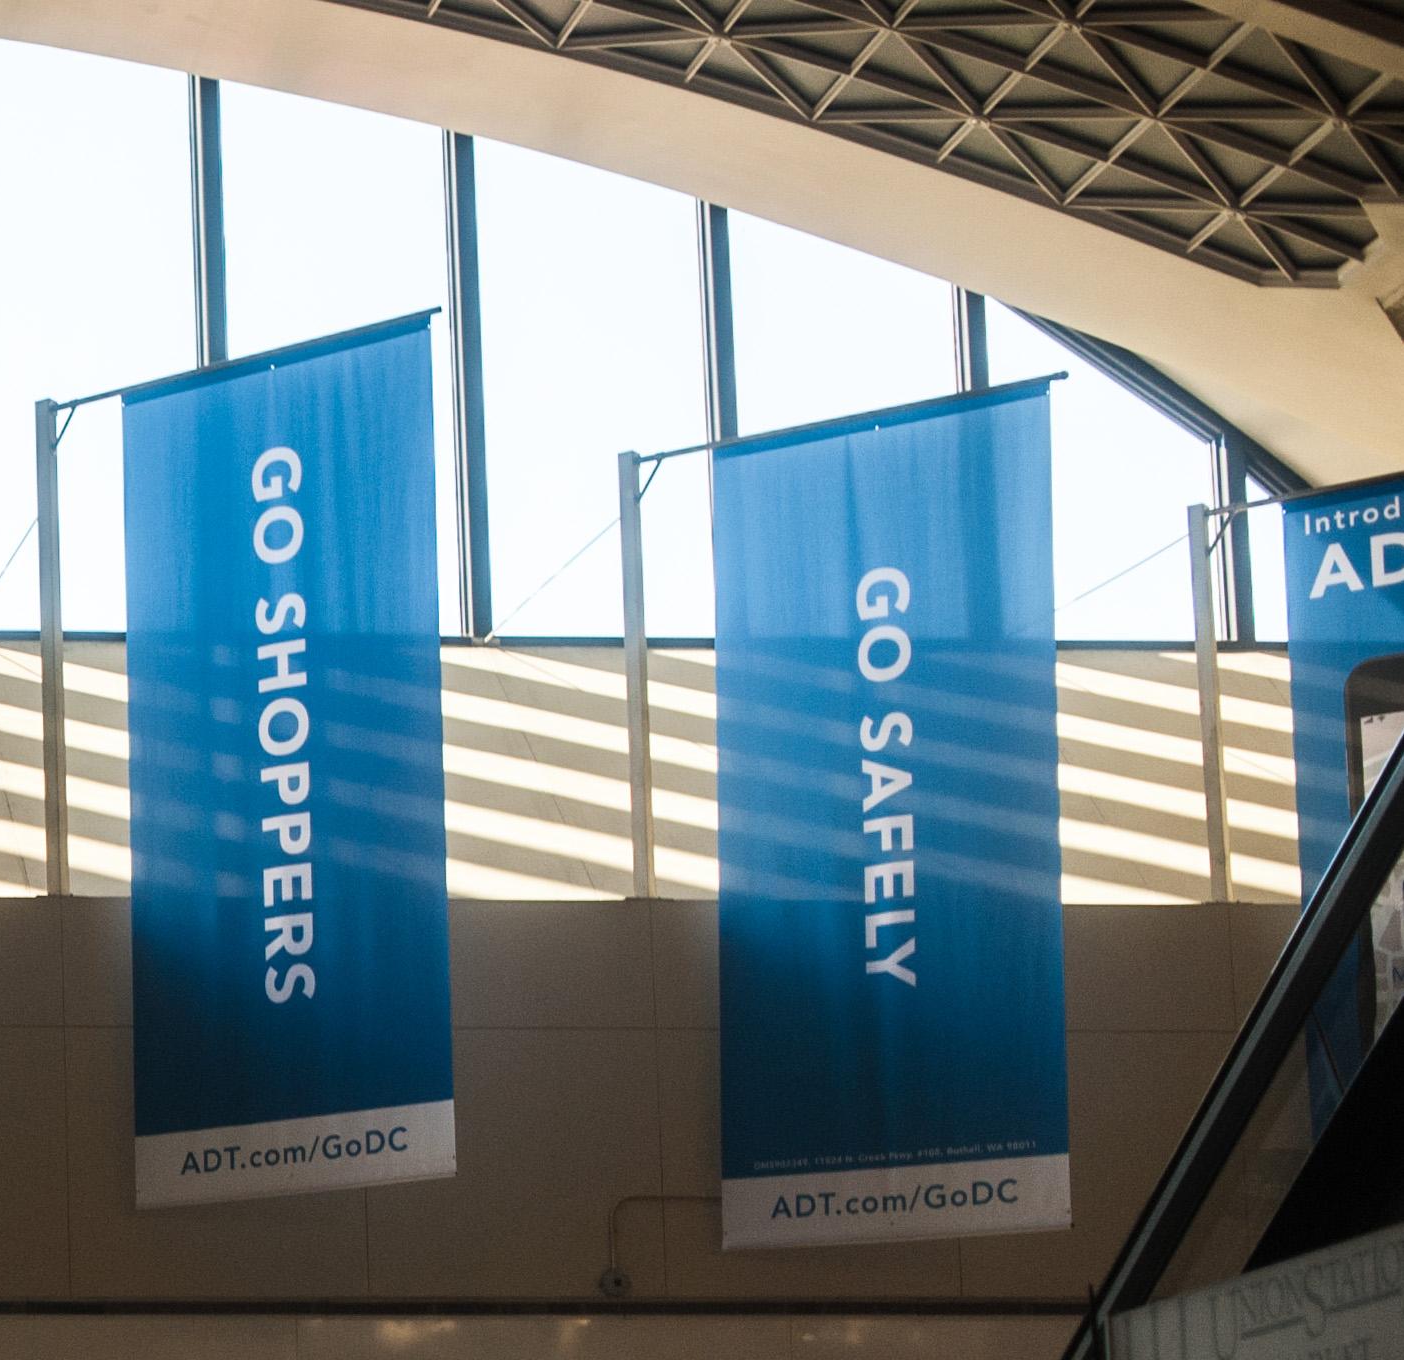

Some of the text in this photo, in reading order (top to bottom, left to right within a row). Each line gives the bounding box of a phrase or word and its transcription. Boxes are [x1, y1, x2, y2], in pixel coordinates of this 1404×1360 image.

[251, 446, 316, 1004] GO SHOPPERS
[855, 566, 917, 988] GO SAFELY
[180, 1124, 409, 1177] ADT.com/GoDC
[770, 1178, 1019, 1220] ADT.com/GoDC
